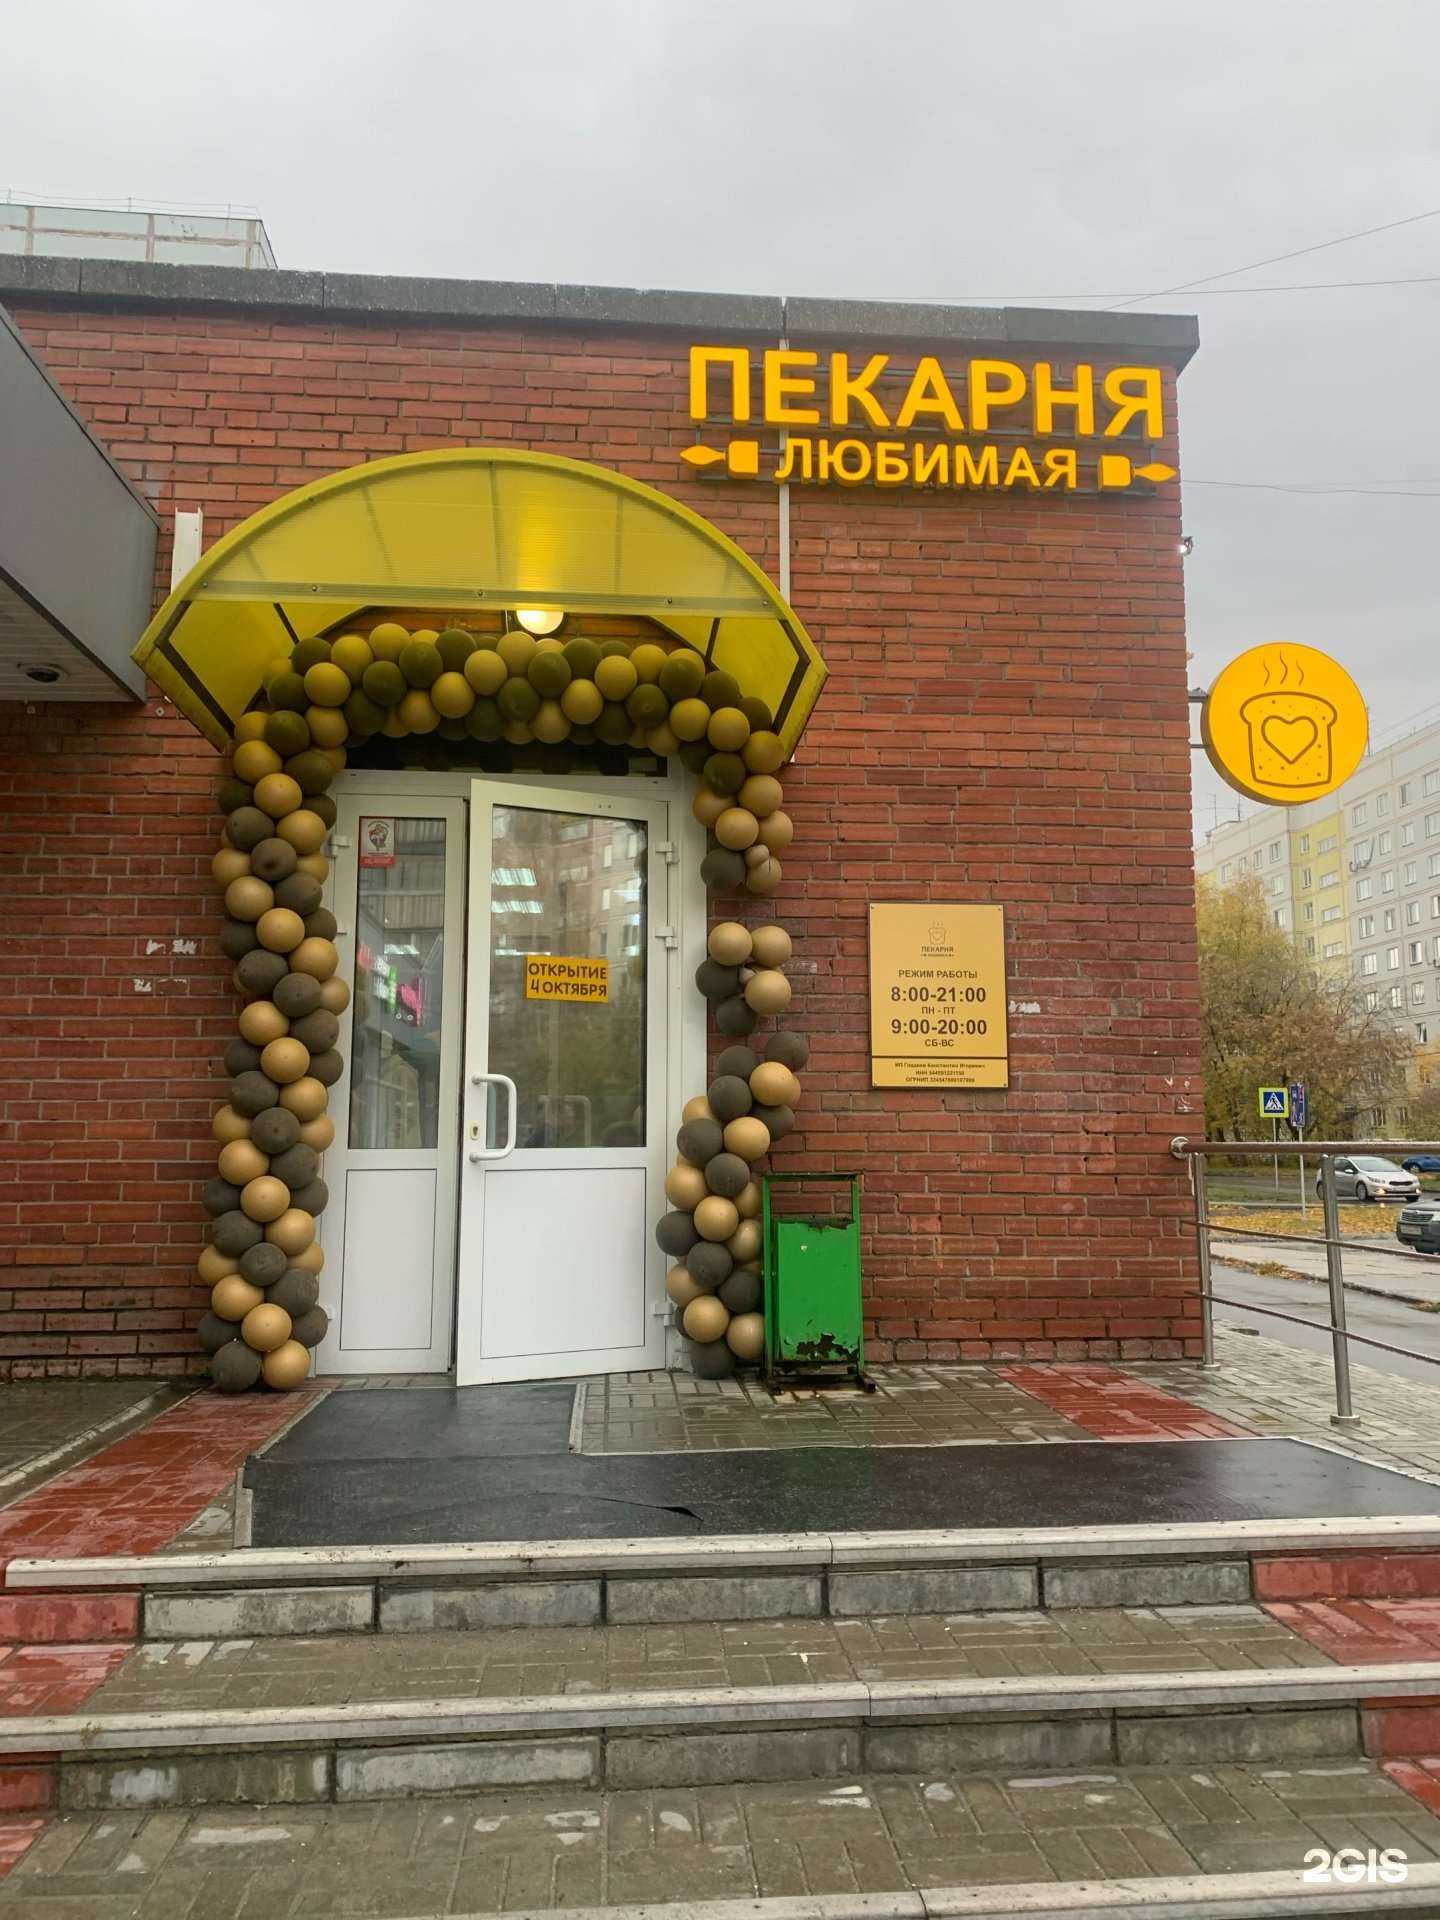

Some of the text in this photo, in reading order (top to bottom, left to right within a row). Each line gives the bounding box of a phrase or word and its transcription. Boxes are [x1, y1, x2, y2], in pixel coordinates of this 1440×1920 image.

[689, 345, 1165, 440] ПЕКАРНЯ
[774, 438, 1078, 491] ЛЮБИМАЯ
[528, 962, 608, 980] ОТКРЫТИЕ
[898, 969, 978, 979] РЕЖИМ РАБОТЫ
[531, 979, 608, 997] 4 ОКТЯБРЯ
[890, 986, 987, 1003] 8:00-21:00
[921, 1006, 935, 1015] ПН
[943, 1007, 956, 1015] ПТ
[890, 1018, 988, 1035] 9:00-20:00
[924, 1038, 955, 1047] СБ-ВС
